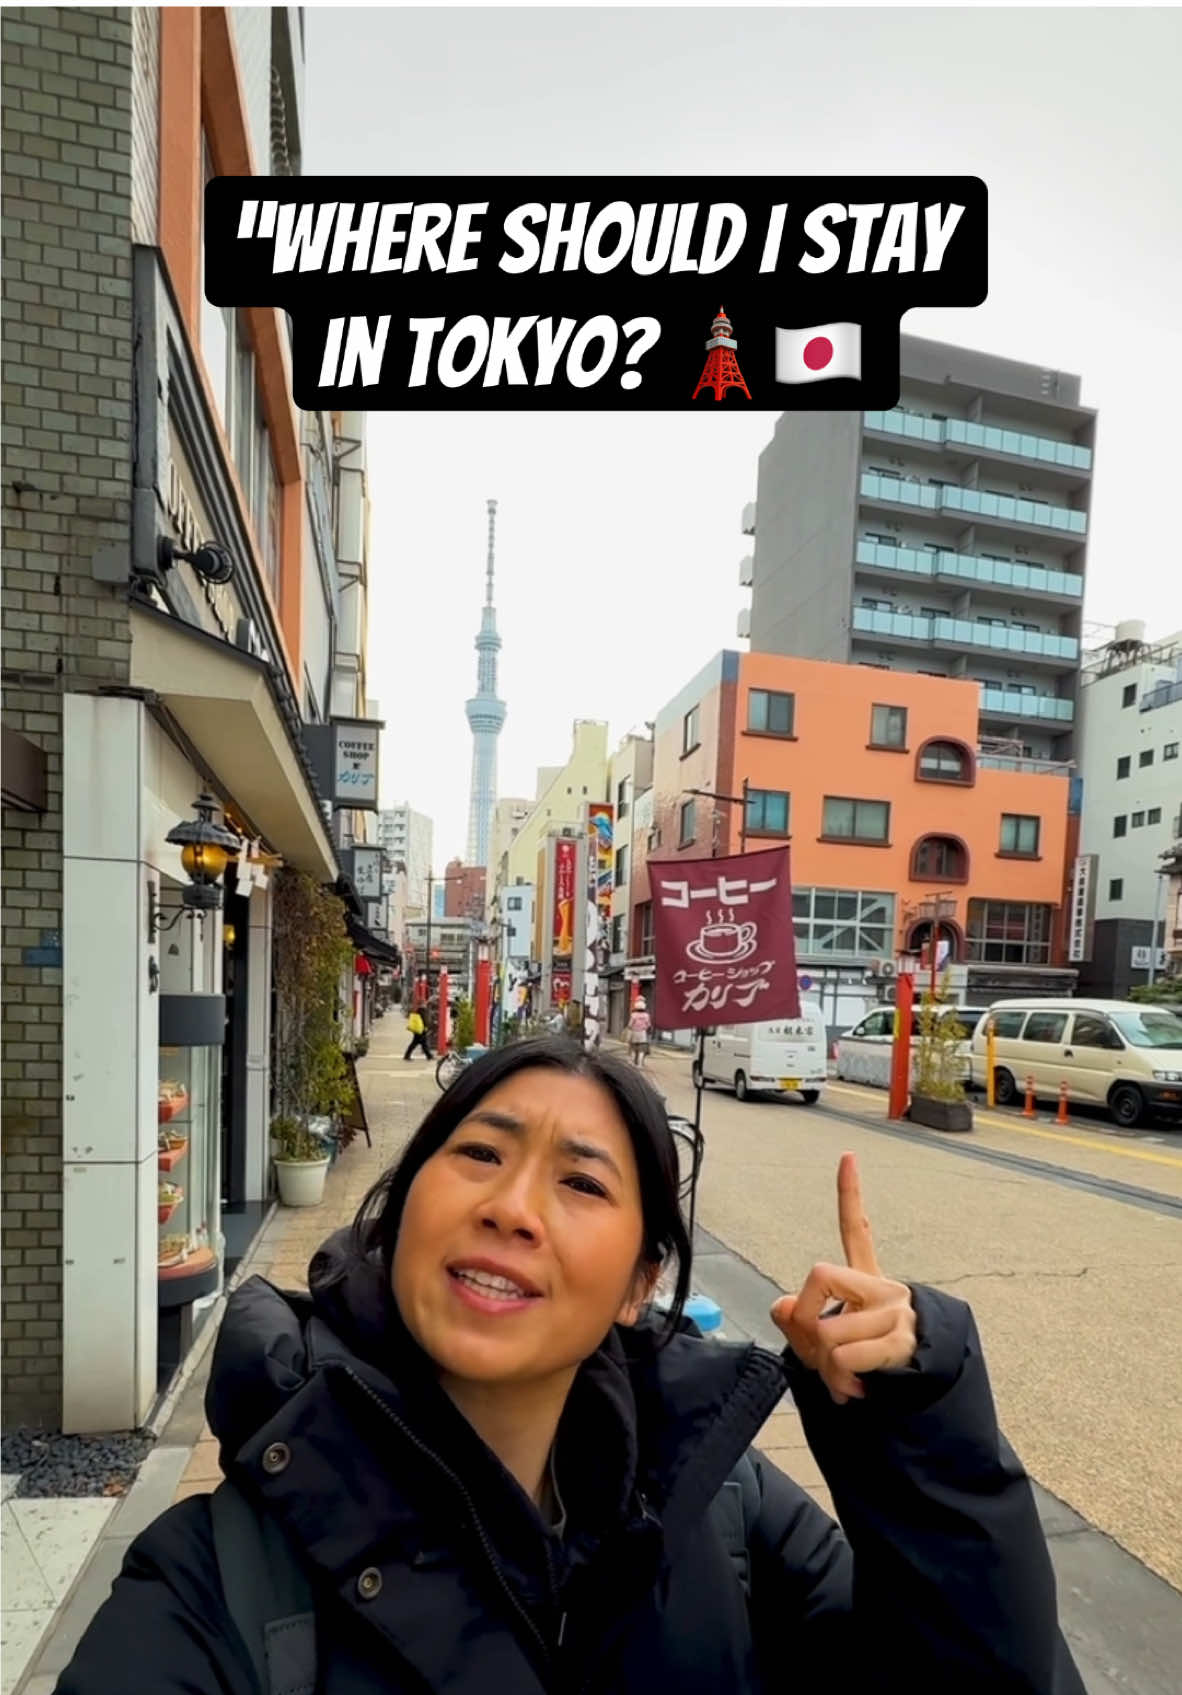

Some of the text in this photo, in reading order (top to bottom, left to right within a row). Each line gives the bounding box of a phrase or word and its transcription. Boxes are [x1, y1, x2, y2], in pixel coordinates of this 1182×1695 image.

[338, 740, 375, 751] COFFEE
[343, 751, 370, 760] SHOP
[660, 876, 777, 908] コーヒー
[672, 960, 776, 984] コーヒーショップ
